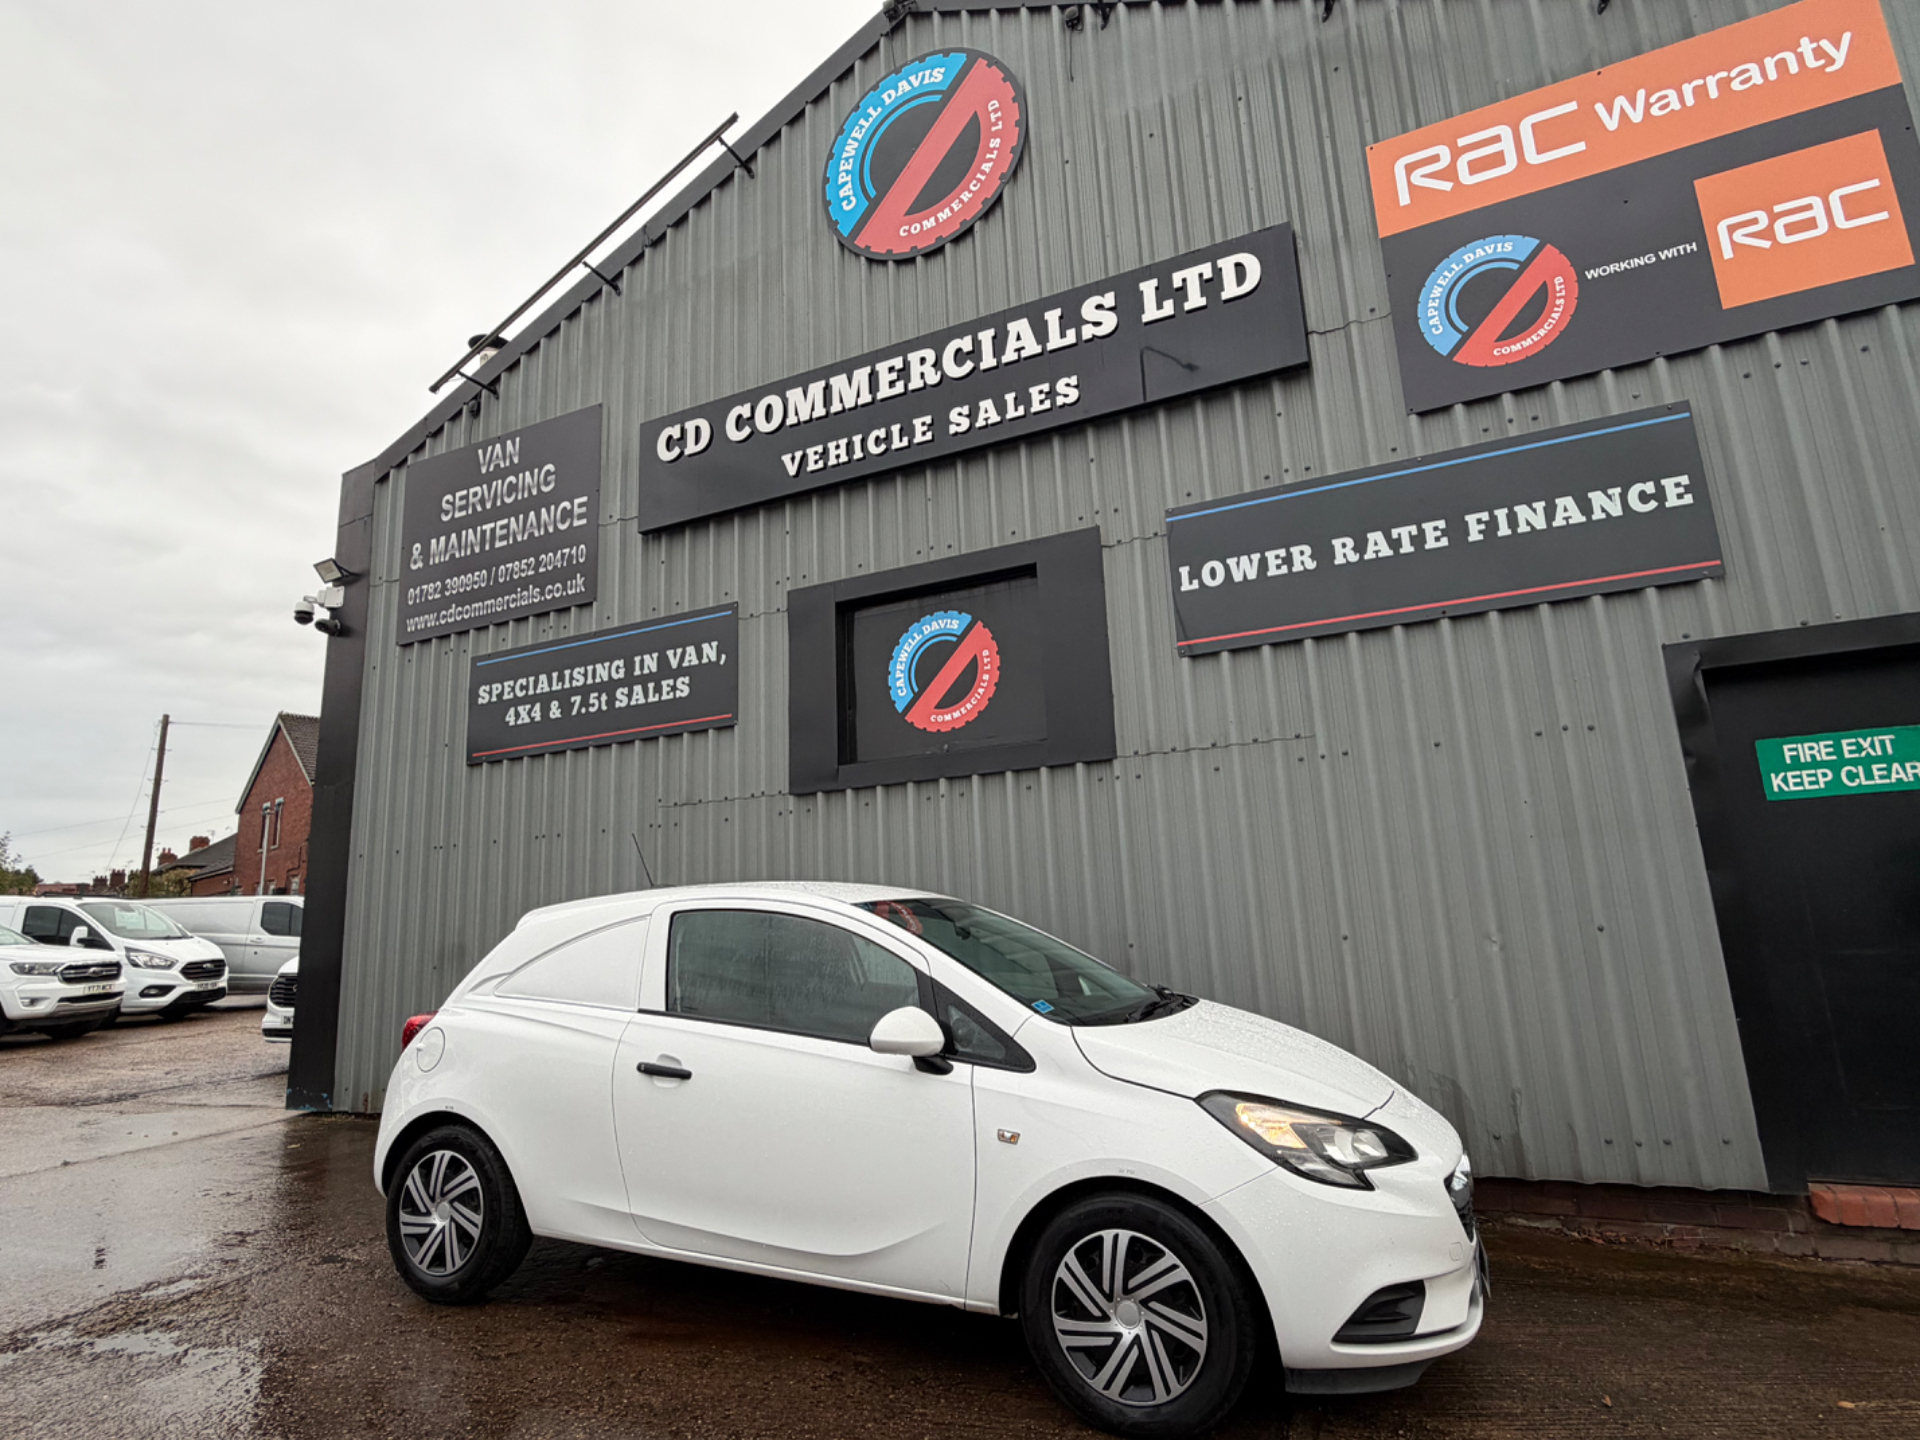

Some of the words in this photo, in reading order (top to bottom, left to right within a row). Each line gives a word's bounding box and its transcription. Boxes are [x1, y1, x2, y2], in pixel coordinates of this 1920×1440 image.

[1593, 30, 1852, 133] Warranty
[837, 106, 883, 211] CAPEWELL
[881, 66, 946, 106] DAVIS
[899, 137, 1001, 237] COMMERCIALS
[987, 99, 1003, 132] LTD
[1427, 262, 1464, 336] CAPEWELL
[1462, 241, 1514, 264] DAVIS
[1584, 252, 1656, 280] WORKING
[1658, 241, 1698, 265] WITH
[1493, 298, 1565, 356] COMMERCIALS
[1553, 276, 1566, 297] LTD
[656, 416, 711, 463] CD
[724, 291, 1119, 442] COMMERCIALS
[1138, 252, 1262, 325] LTD
[477, 436, 520, 474] VAN
[781, 415, 933, 478] VEHICLE
[948, 374, 1081, 436] SALES
[440, 463, 556, 522] SERVICING
[409, 542, 423, 570] &
[429, 495, 588, 566] MAINTENANCE
[1178, 544, 1317, 592] LOWER
[1331, 519, 1450, 566] RATE
[1464, 474, 1694, 544] FINANCE
[406, 573, 586, 633] www.cdcommercials.co.uk
[407, 580, 441, 606] 01782
[444, 569, 487, 596] 390950
[498, 555, 535, 583] 07852
[538, 544, 586, 575] 204710
[477, 657, 626, 705] SPECIALISING
[634, 650, 659, 676] IN
[666, 641, 727, 670] VAN,
[895, 632, 923, 696] CAPEWELL
[921, 618, 960, 634] DAVIS
[930, 673, 990, 722] COMMERCIALS
[982, 649, 991, 670] LTD
[505, 703, 541, 727] 4X4
[549, 699, 562, 719] &
[570, 695, 608, 716] 7.5t
[615, 676, 691, 709] SALES
[1770, 768, 1833, 792] KEEP
[1840, 761, 1920, 787] CLEAR
[1783, 740, 1837, 764] FIRE
[1841, 734, 1895, 758] EXIT
